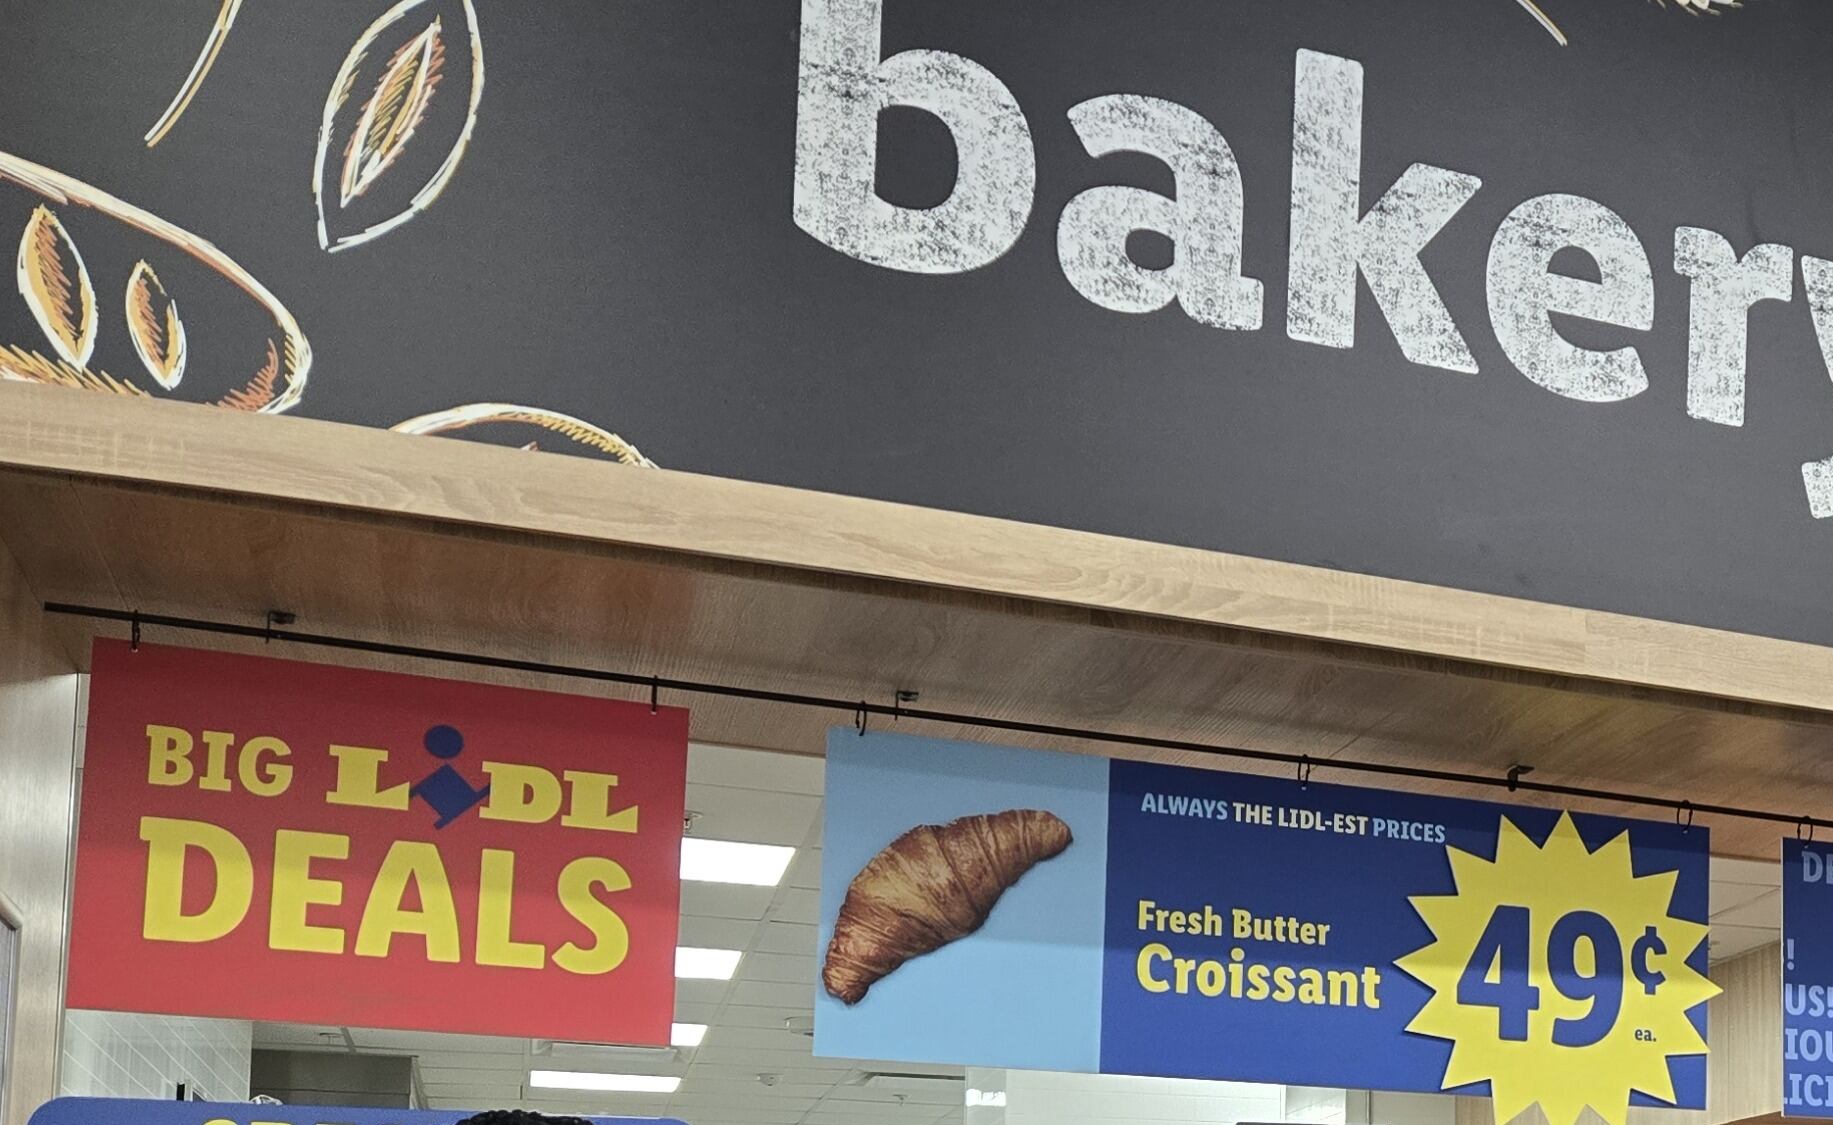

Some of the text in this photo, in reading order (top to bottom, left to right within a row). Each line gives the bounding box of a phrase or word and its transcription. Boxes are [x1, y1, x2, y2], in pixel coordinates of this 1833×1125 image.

[146, 724, 294, 797] BIG
[1141, 792, 1446, 844] ALWAYS THE LIDL-EST PRICES
[140, 816, 632, 975] DEALS
[1137, 900, 1331, 946] Fresh Butter
[1136, 943, 1381, 1010] Croissant
[1456, 903, 1669, 1049] 49¢
[1634, 1027, 1658, 1043] ea.
